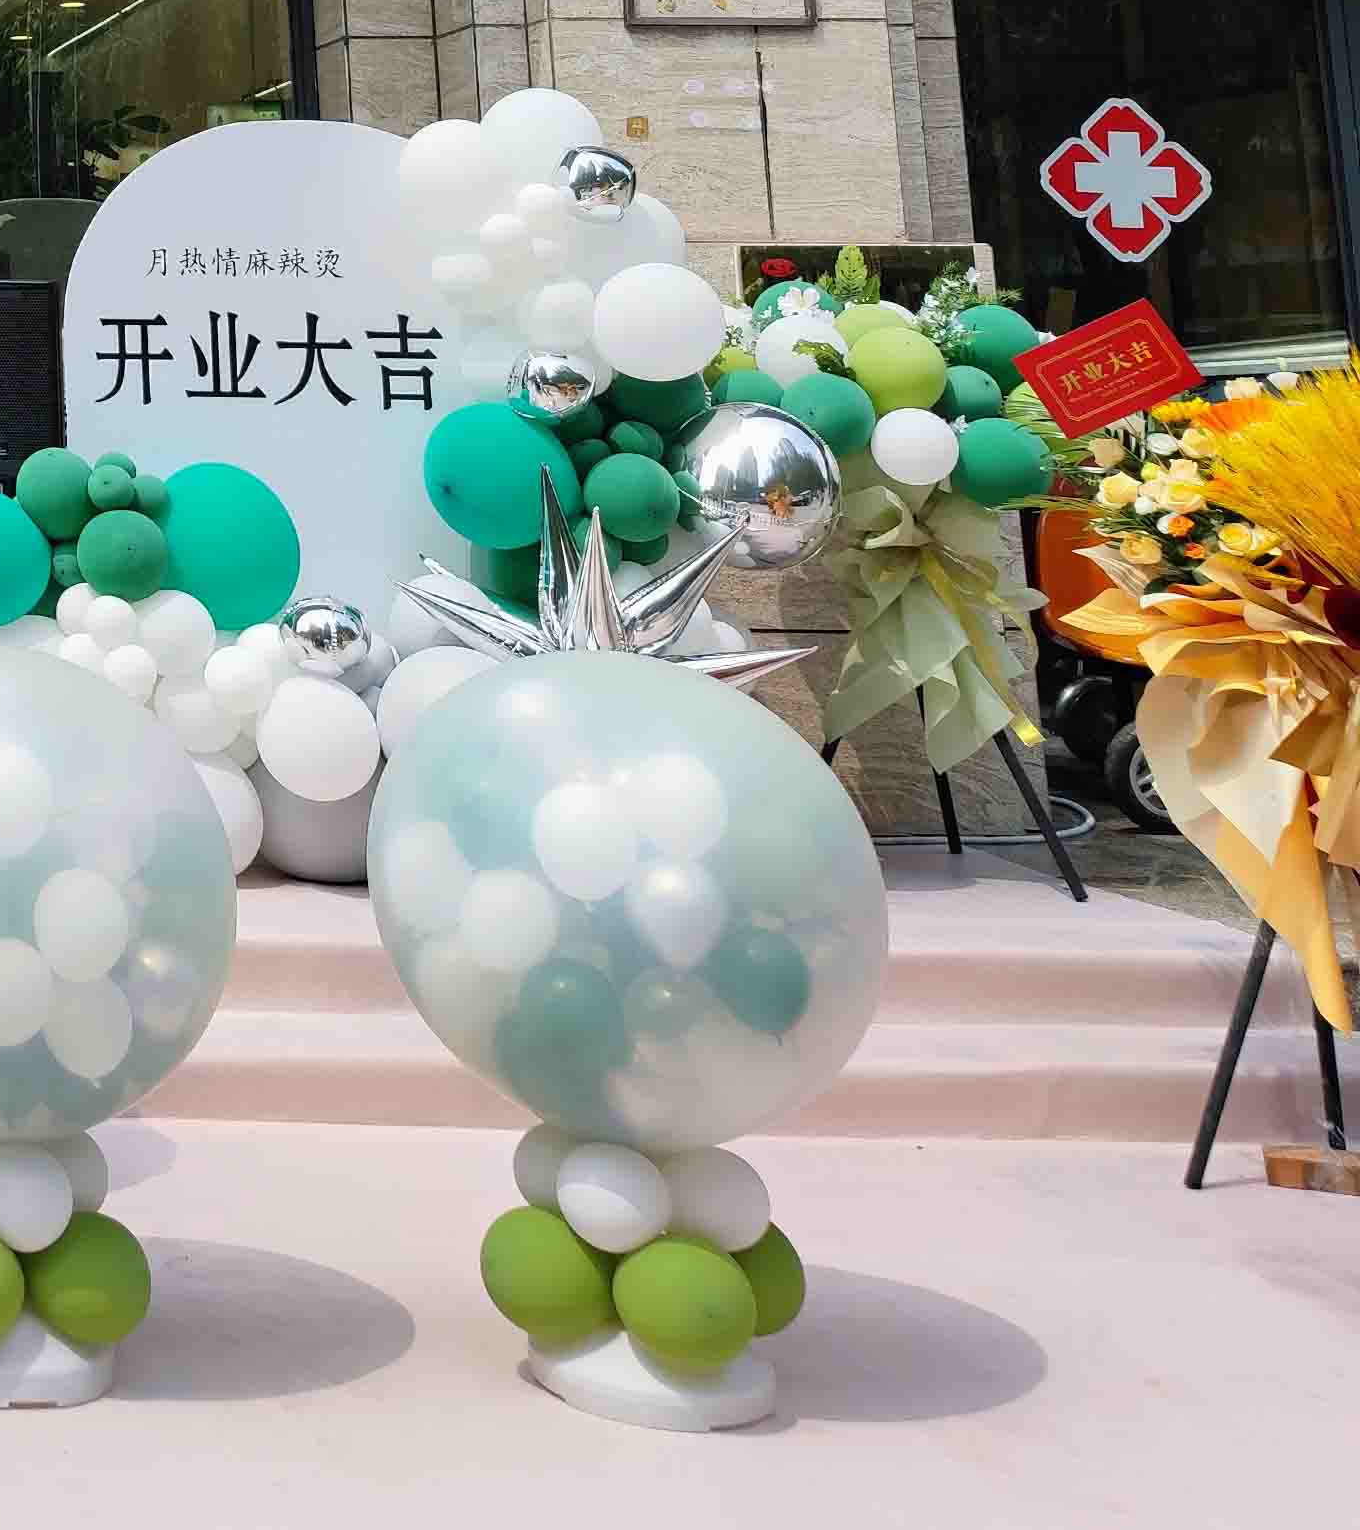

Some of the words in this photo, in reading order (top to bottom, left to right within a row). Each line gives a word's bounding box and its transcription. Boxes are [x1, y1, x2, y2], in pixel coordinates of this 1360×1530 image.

[144, 247, 344, 279] 月热情麻辣烫
[95, 310, 444, 411] 开业大吉
[1056, 341, 1153, 397] 开业大吉
